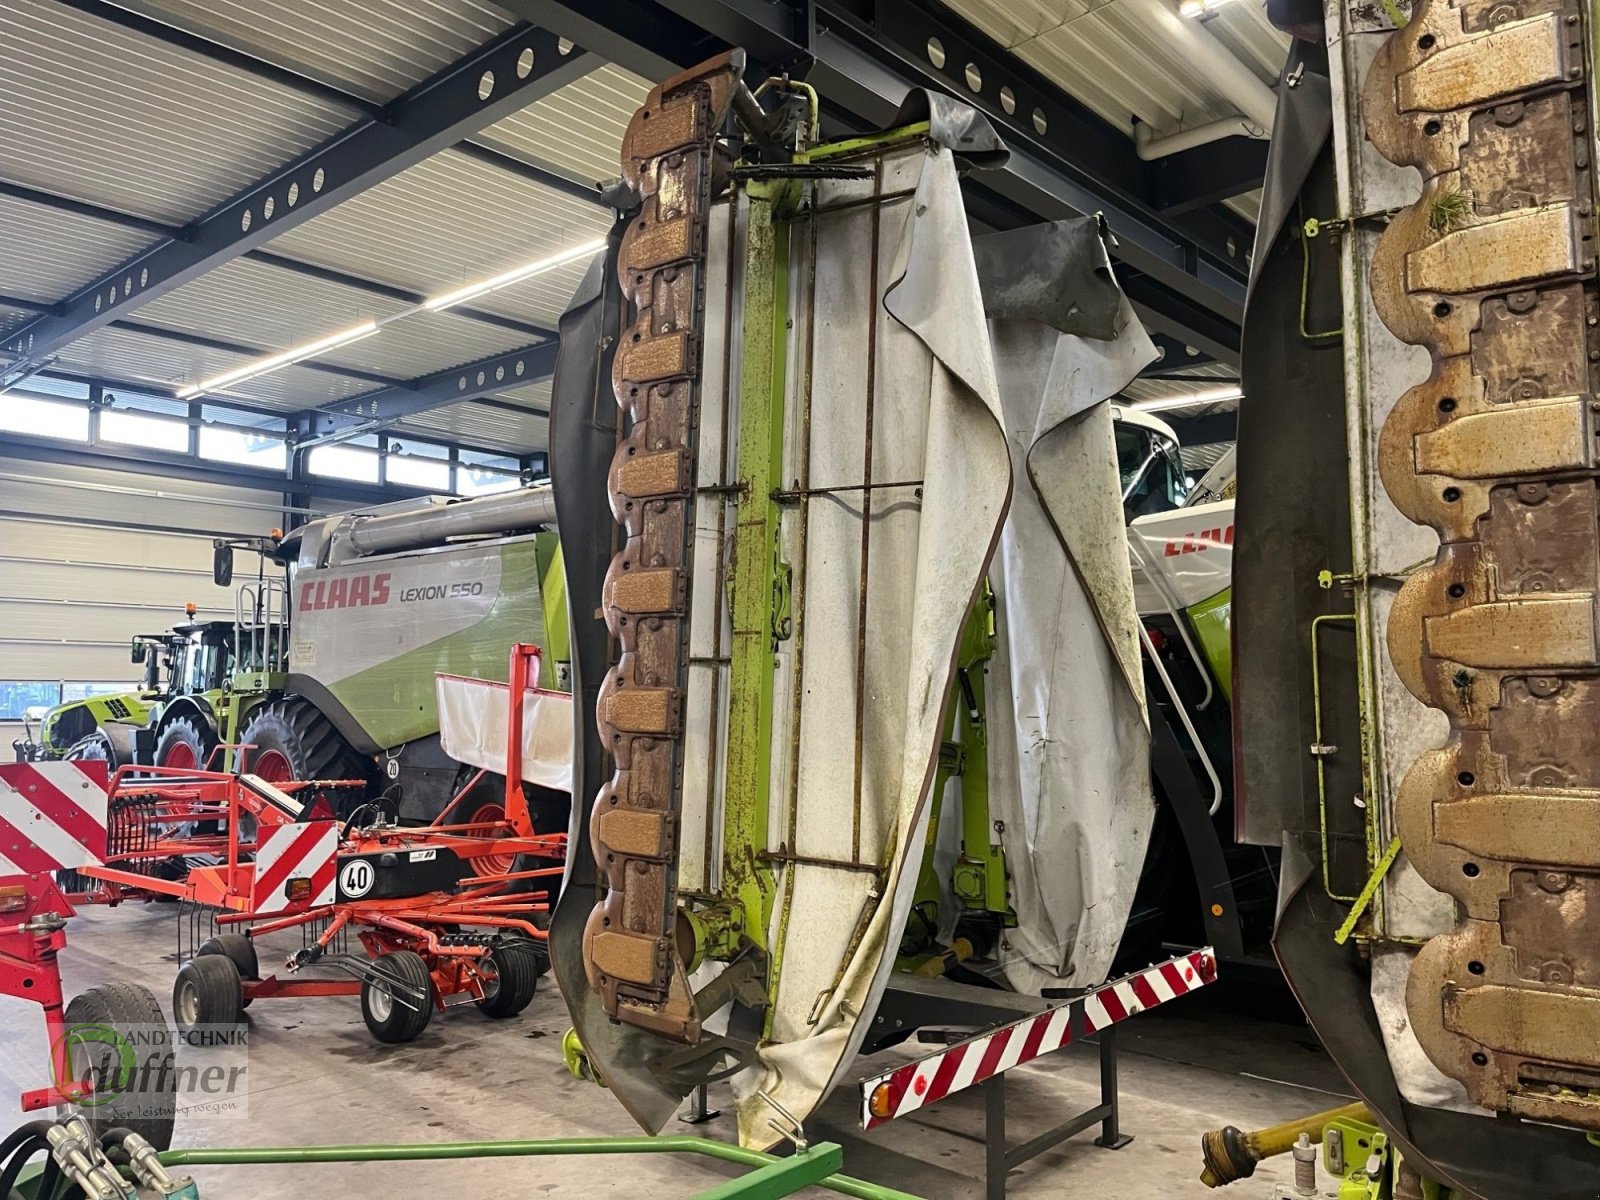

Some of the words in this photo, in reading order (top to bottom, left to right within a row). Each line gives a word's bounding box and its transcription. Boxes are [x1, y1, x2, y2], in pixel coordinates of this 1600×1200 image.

[299, 573, 392, 612] CLAAS
[400, 585, 448, 602] LEXION
[450, 582, 483, 598] 550
[389, 762, 397, 776] 20
[346, 866, 367, 890] 40
